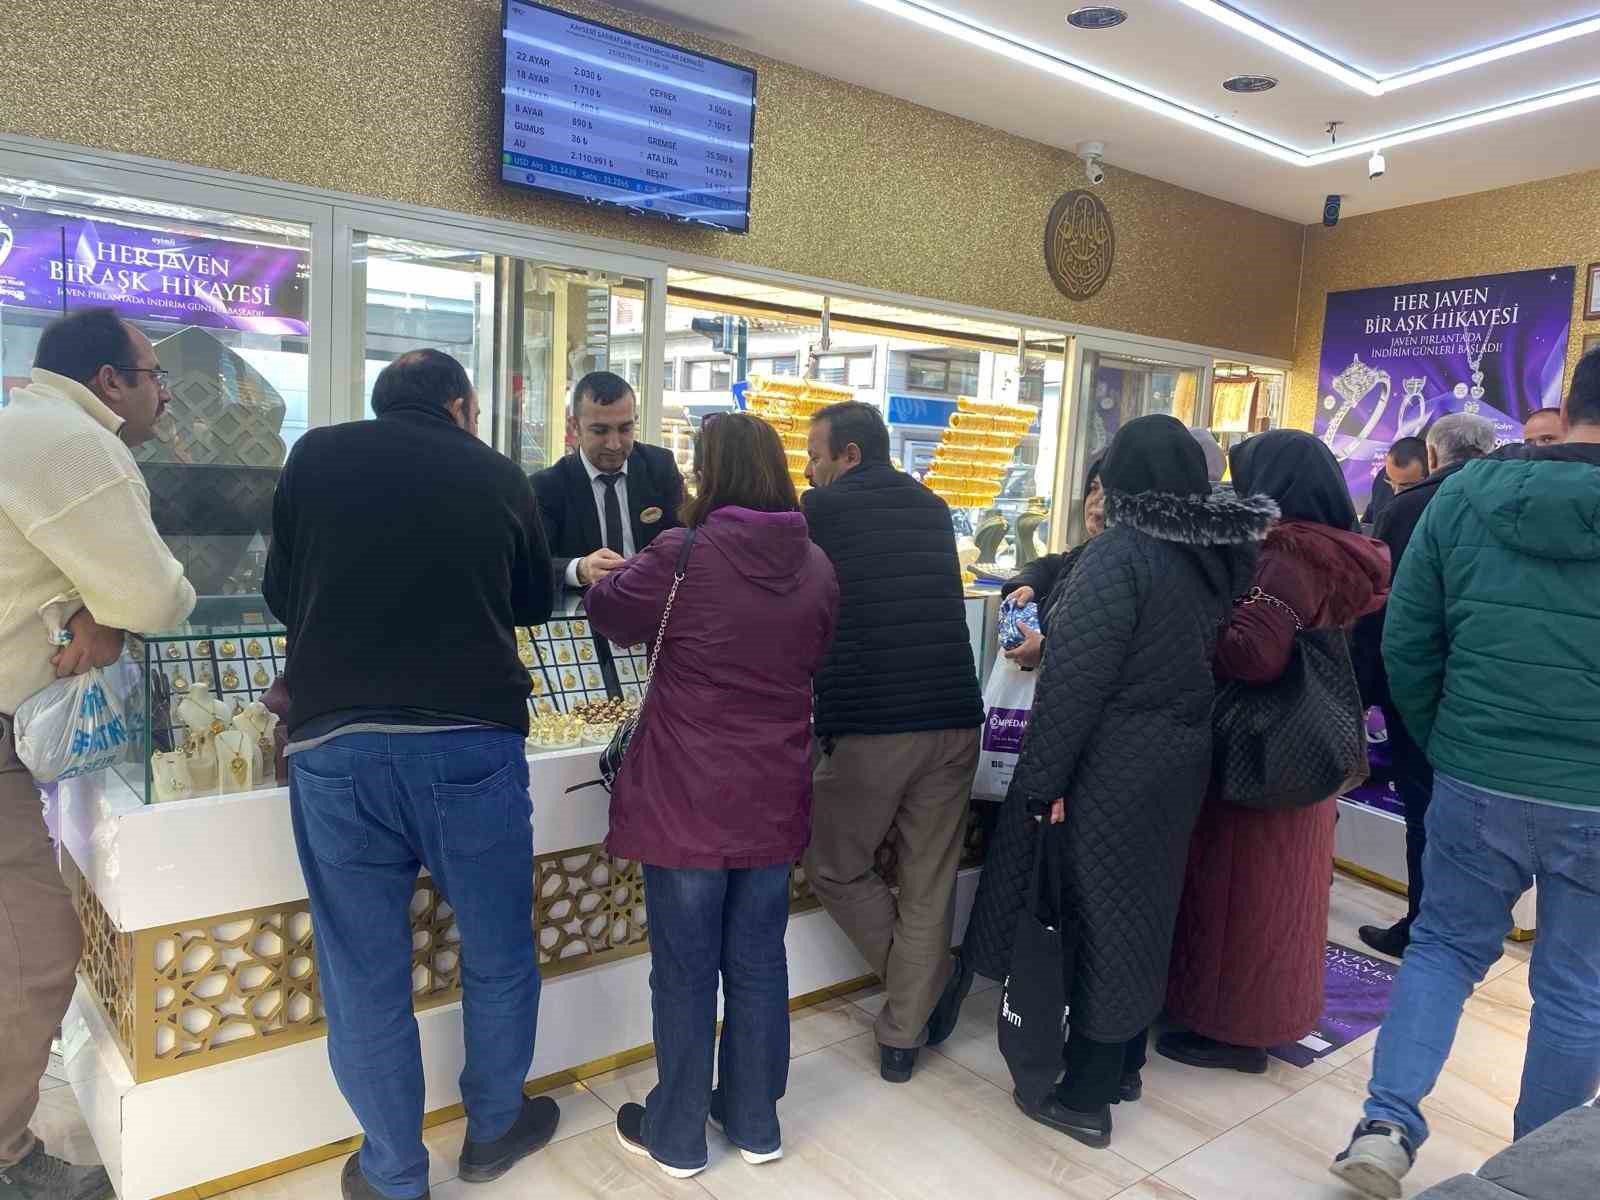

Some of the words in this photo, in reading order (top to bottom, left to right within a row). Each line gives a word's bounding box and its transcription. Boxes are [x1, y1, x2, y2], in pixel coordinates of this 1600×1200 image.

[516, 51, 527, 62] 22
[529, 55, 550, 68] AYAR
[574, 67, 595, 80] 2.030
[516, 69, 527, 79] 18
[528, 72, 549, 85] AYAR
[522, 105, 543, 118] AYAR
[647, 152, 661, 163] ATA
[97, 240, 152, 267] HER
[157, 248, 230, 277] JAVEN
[49, 258, 100, 286] BİR
[101, 268, 150, 294] AŞK
[162, 275, 272, 306] HİKAYESİ
[1393, 293, 1429, 313] HER
[1432, 287, 1489, 311] JAVEN
[1365, 314, 1392, 335] BİR
[1394, 313, 1428, 335] AŞK
[1432, 303, 1520, 330] HİKAYESİ
[1371, 346, 1410, 358] İNDİRİM
[1412, 343, 1455, 356] GÜNLERİ
[1391, 336, 1418, 349] JAVEN
